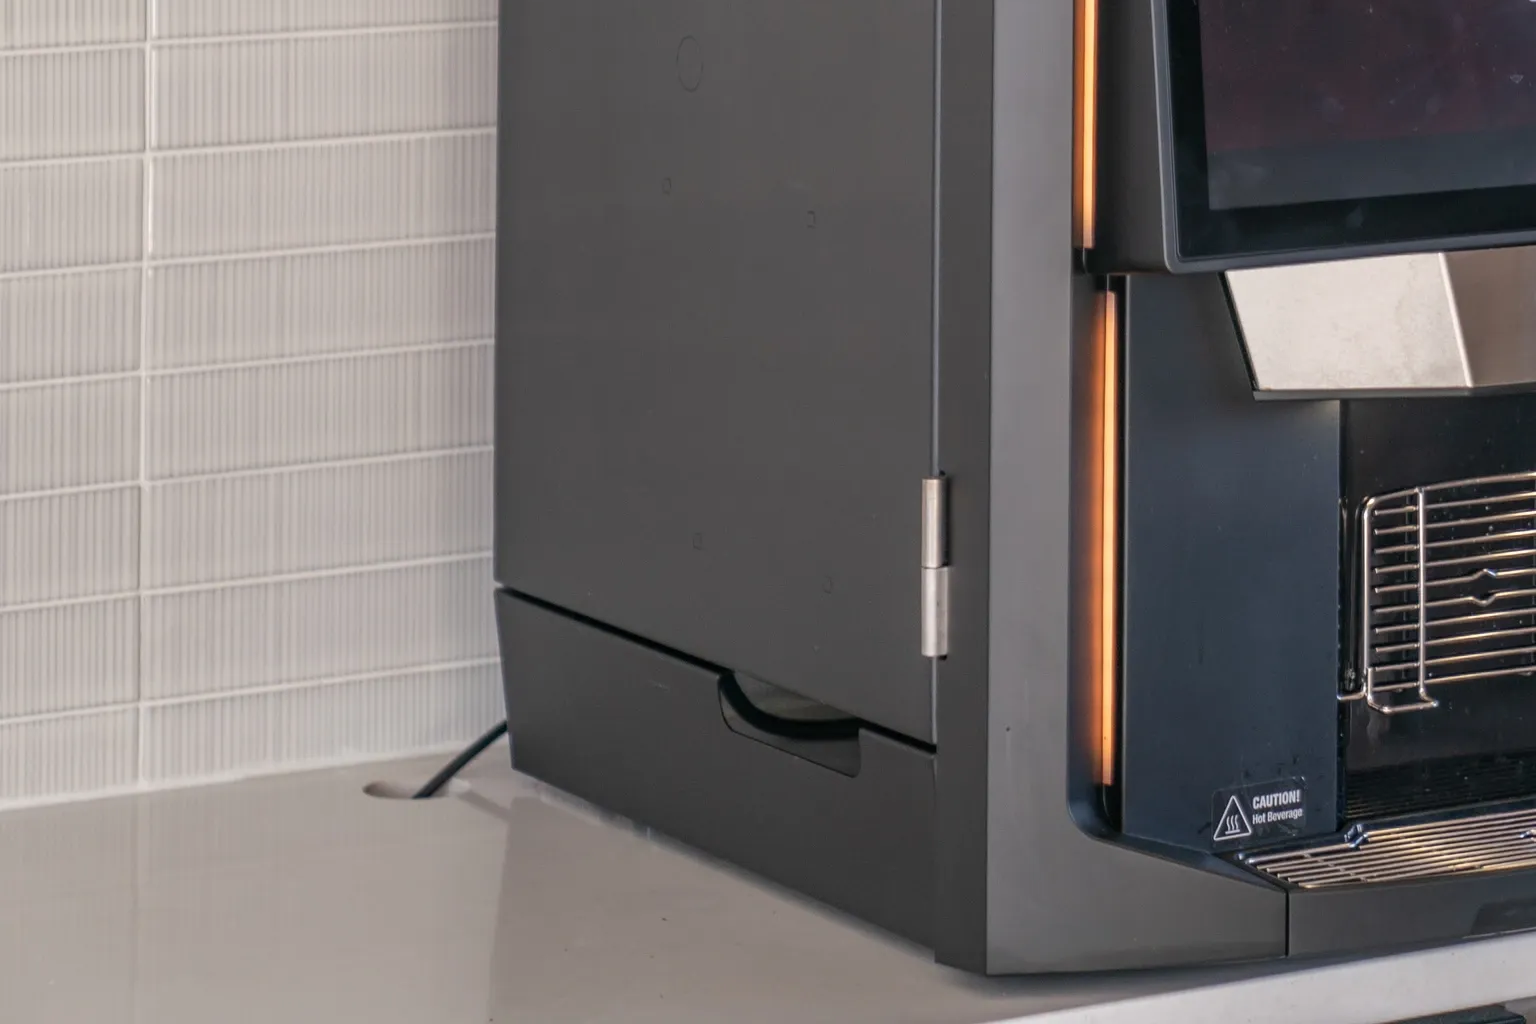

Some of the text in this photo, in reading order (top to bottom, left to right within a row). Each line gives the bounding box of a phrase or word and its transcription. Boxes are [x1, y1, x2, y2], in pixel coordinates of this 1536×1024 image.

[1253, 789, 1300, 809] CAUTION!
[1252, 808, 1303, 824] Hot Beverage
